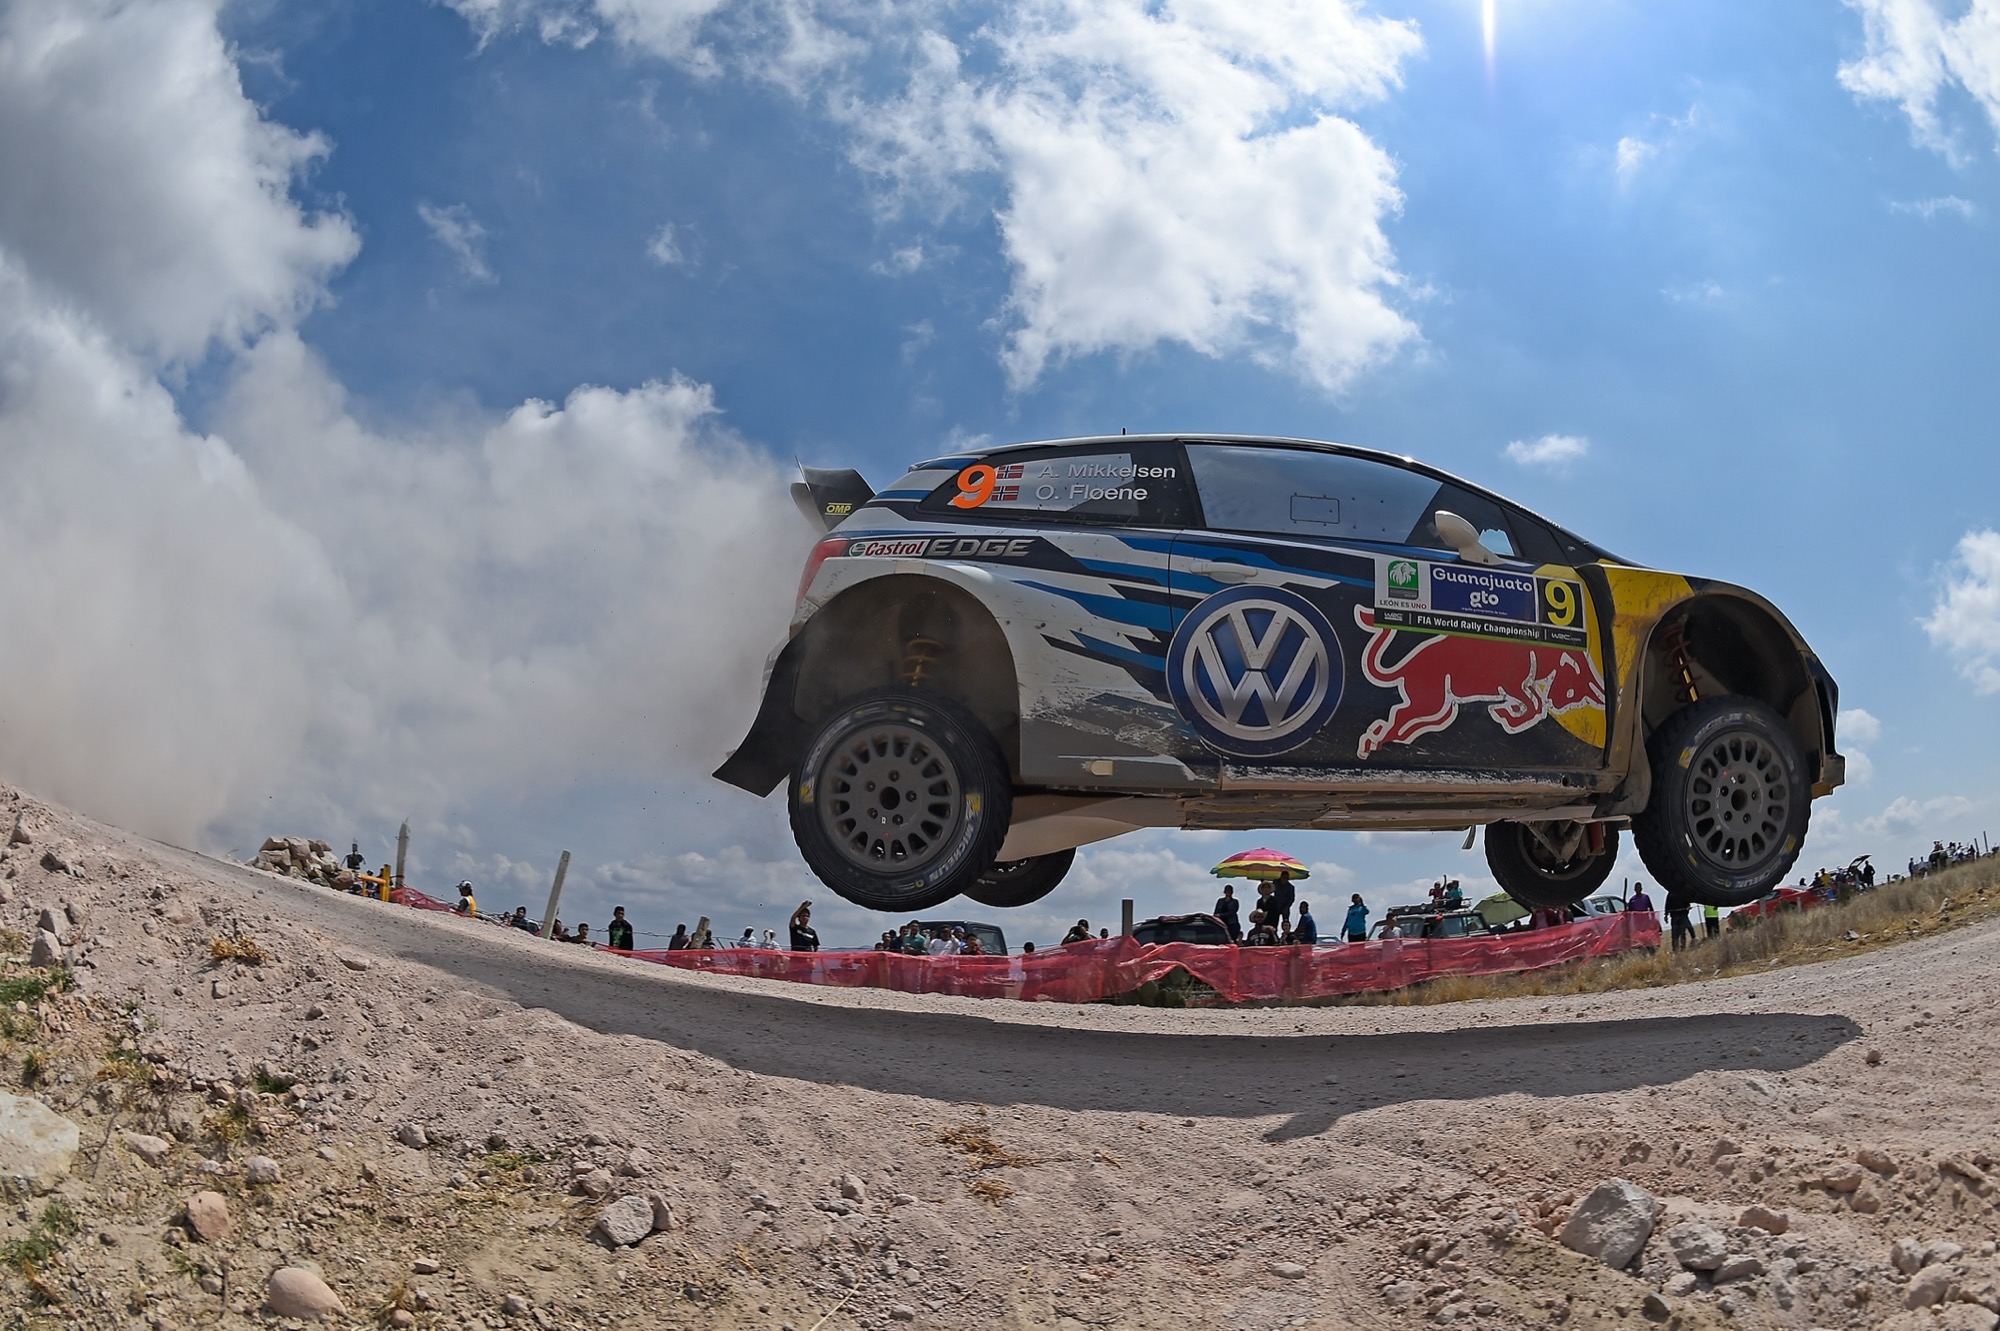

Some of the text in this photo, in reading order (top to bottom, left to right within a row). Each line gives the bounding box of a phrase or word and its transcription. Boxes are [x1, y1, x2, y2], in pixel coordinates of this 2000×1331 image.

[1038, 464, 1176, 479] A. Mikkelsen
[952, 464, 996, 509] 9
[1035, 484, 1148, 500] O. Fløene
[826, 504, 852, 513] OMP
[865, 538, 1041, 557] Castrol EDGE
[1432, 567, 1533, 594] Guanajuato
[1380, 600, 1399, 608] LEÓN
[1411, 602, 1427, 610] UNO
[1469, 590, 1499, 608] gto
[1545, 581, 1575, 627] 9
[1417, 615, 1540, 639] FIA World Rally Championship
[929, 823, 974, 882] MICHELIN
